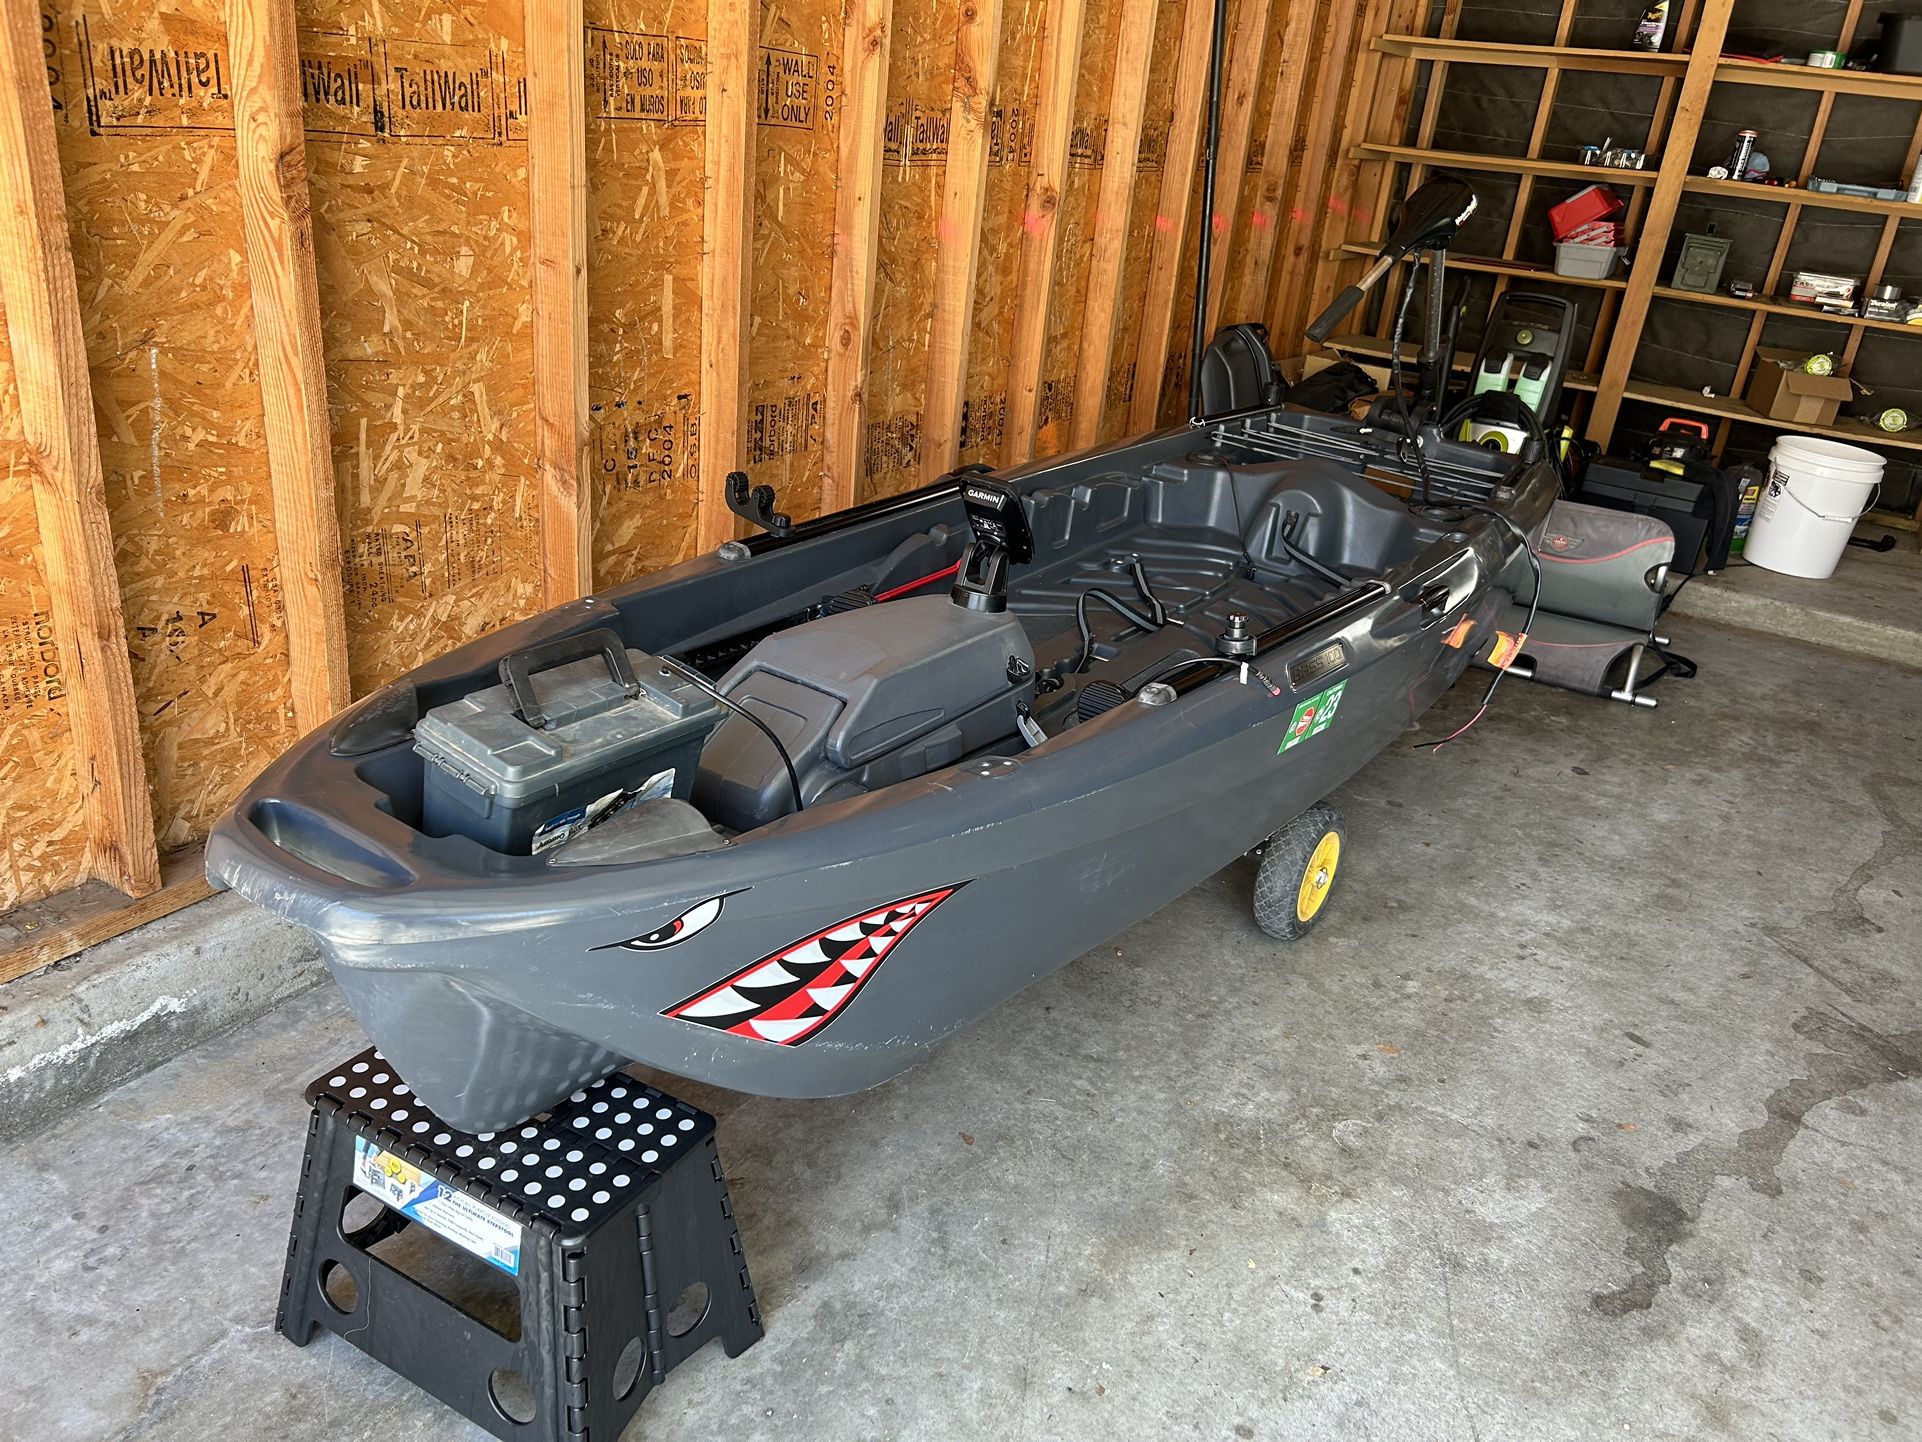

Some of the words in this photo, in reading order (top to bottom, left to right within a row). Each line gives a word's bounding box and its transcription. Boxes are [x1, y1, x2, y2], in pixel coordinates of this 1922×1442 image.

[625, 40, 644, 61] SOLO
[637, 68, 653, 87] USO
[782, 56, 814, 79] WALL
[785, 80, 809, 101] USE
[824, 64, 837, 121] 2004
[625, 93, 636, 113] EN
[639, 94, 665, 115] MUROS
[781, 103, 811, 124] ONLY
[661, 423, 674, 481] 2004
[967, 489, 1000, 504] GARMIN
[21, 620, 37, 671] STRUCTURAL
[33, 610, 66, 702] norbord
[437, 1186, 453, 1203] 12
[462, 1206, 486, 1221] ULTIMATE
[486, 1219, 514, 1238] STEPSTOOL
